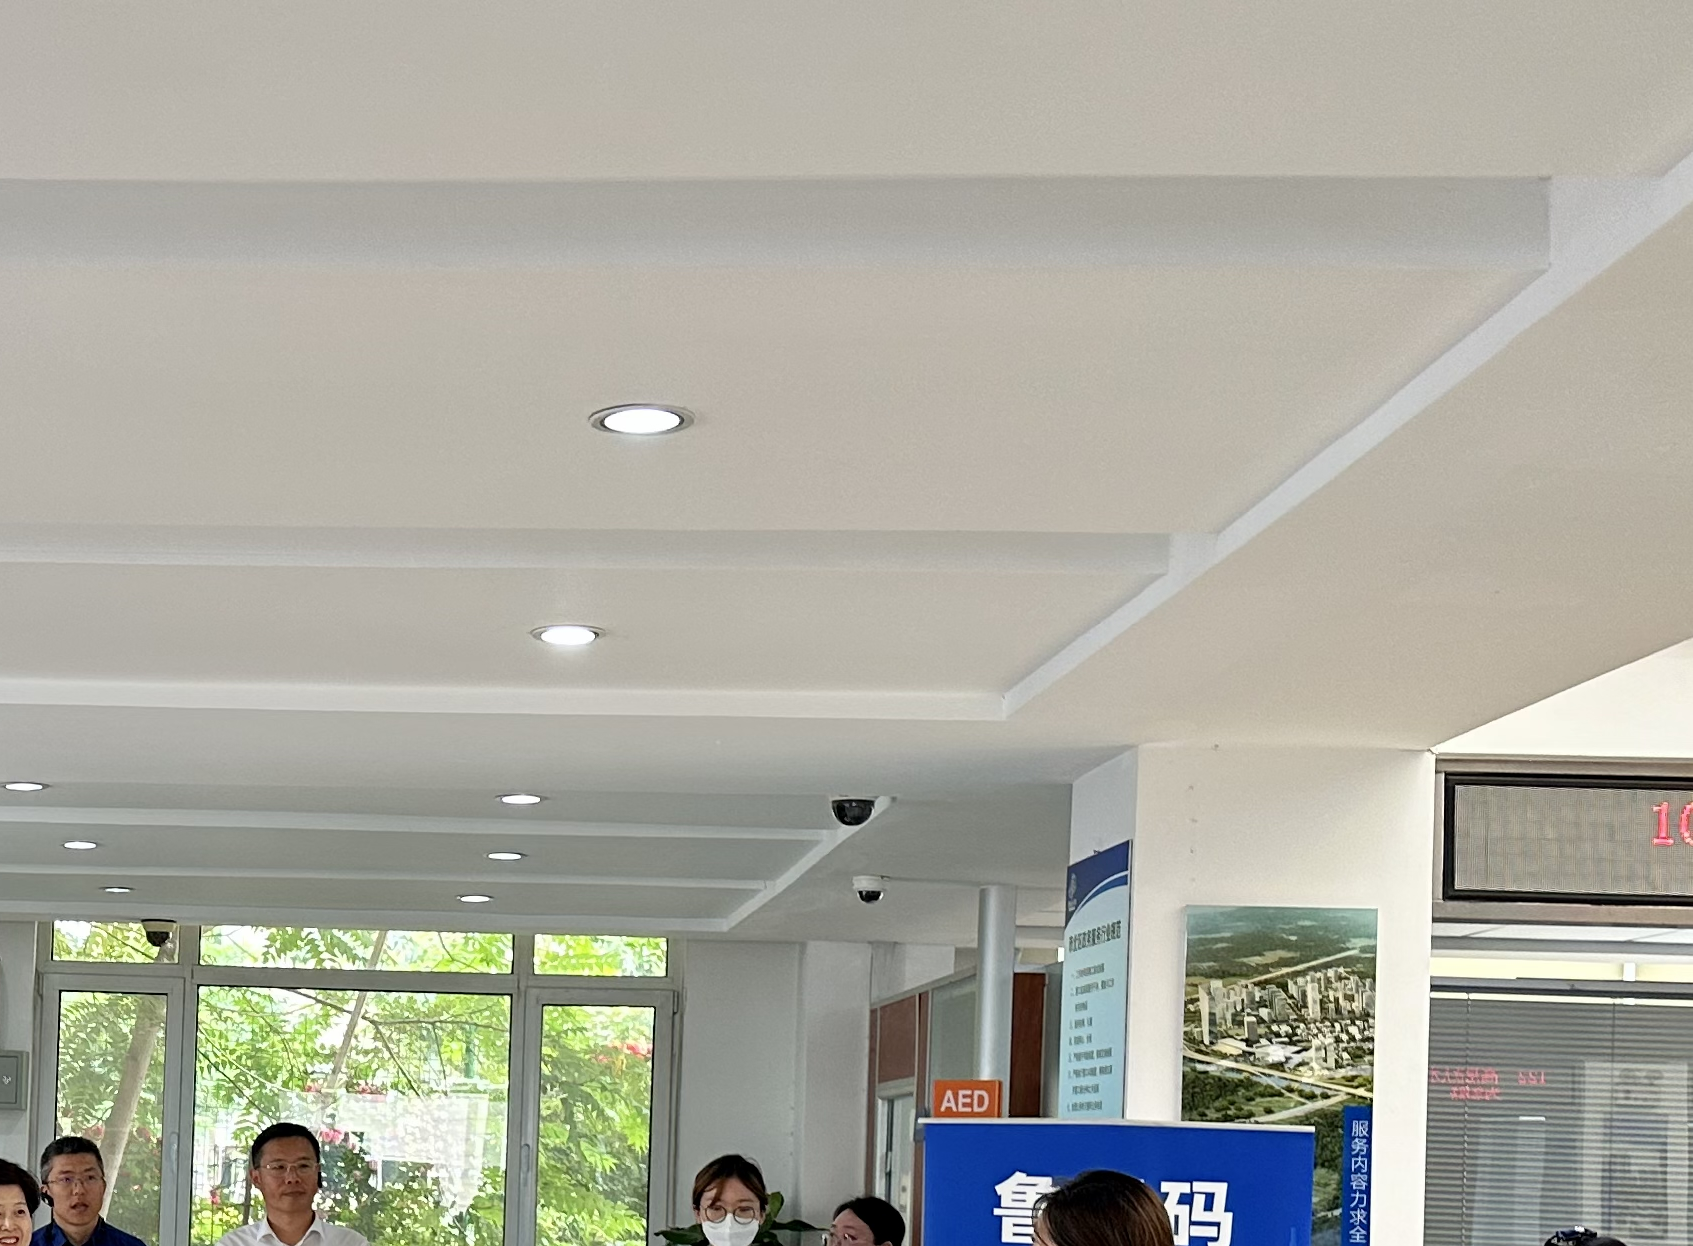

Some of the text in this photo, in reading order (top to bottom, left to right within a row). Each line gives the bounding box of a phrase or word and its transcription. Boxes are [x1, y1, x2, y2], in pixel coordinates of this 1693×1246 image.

[940, 1090, 989, 1112] AED
[1349, 1120, 1369, 1243] 服务内容力求全
